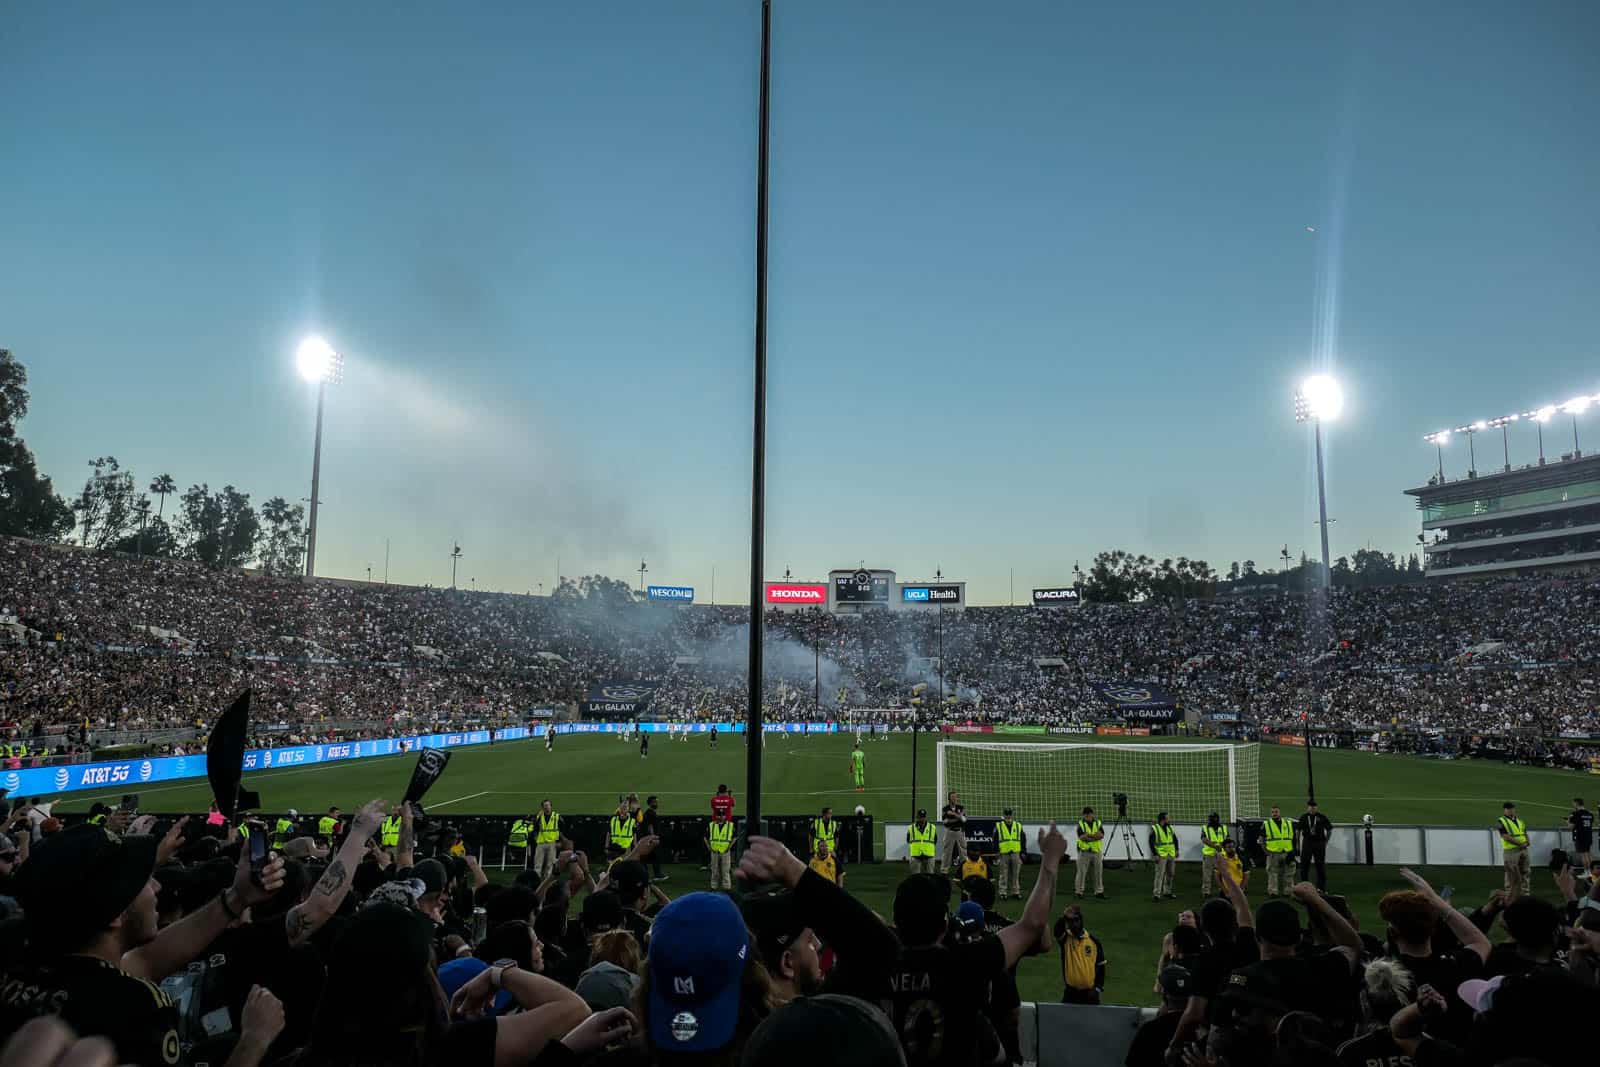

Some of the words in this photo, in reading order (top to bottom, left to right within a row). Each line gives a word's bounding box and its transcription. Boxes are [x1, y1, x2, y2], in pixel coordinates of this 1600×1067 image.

[650, 589, 685, 598] WESCOM
[771, 590, 821, 598] HONDA
[929, 590, 957, 599] Health
[1042, 590, 1077, 599] ACURA
[589, 703, 600, 711] LA
[605, 703, 635, 711] GALAXY
[1122, 710, 1134, 718] LA
[1138, 710, 1173, 718] GALAXY
[81, 767, 112, 785] AT&T
[111, 765, 130, 781] 5G
[889, 971, 931, 993] VELA
